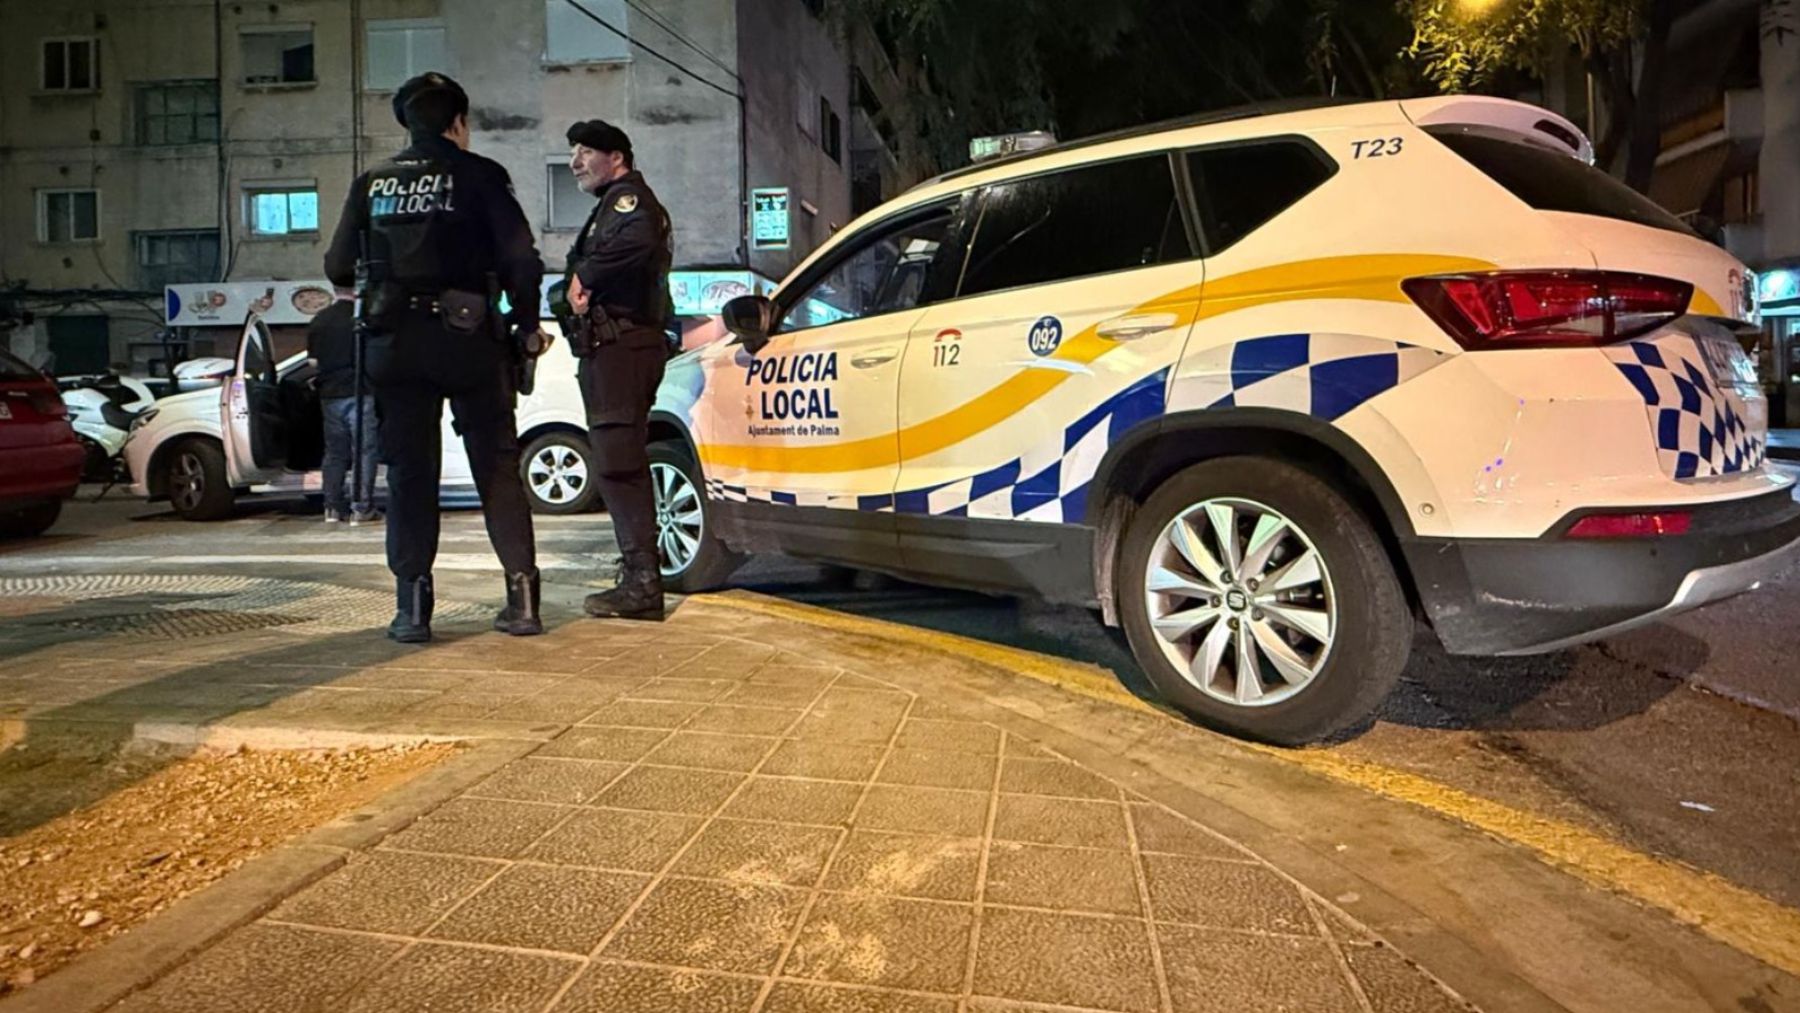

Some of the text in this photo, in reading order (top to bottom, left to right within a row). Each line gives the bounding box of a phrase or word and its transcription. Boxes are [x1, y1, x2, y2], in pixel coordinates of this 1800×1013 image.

[1351, 136, 1404, 159] T23
[396, 193, 455, 214] LOCL
[1032, 326, 1058, 351] 092
[933, 344, 960, 367] 112
[745, 352, 838, 386] POLICIA
[761, 388, 839, 420] LOCAL
[748, 424, 840, 438] Ajuntament de Palma
